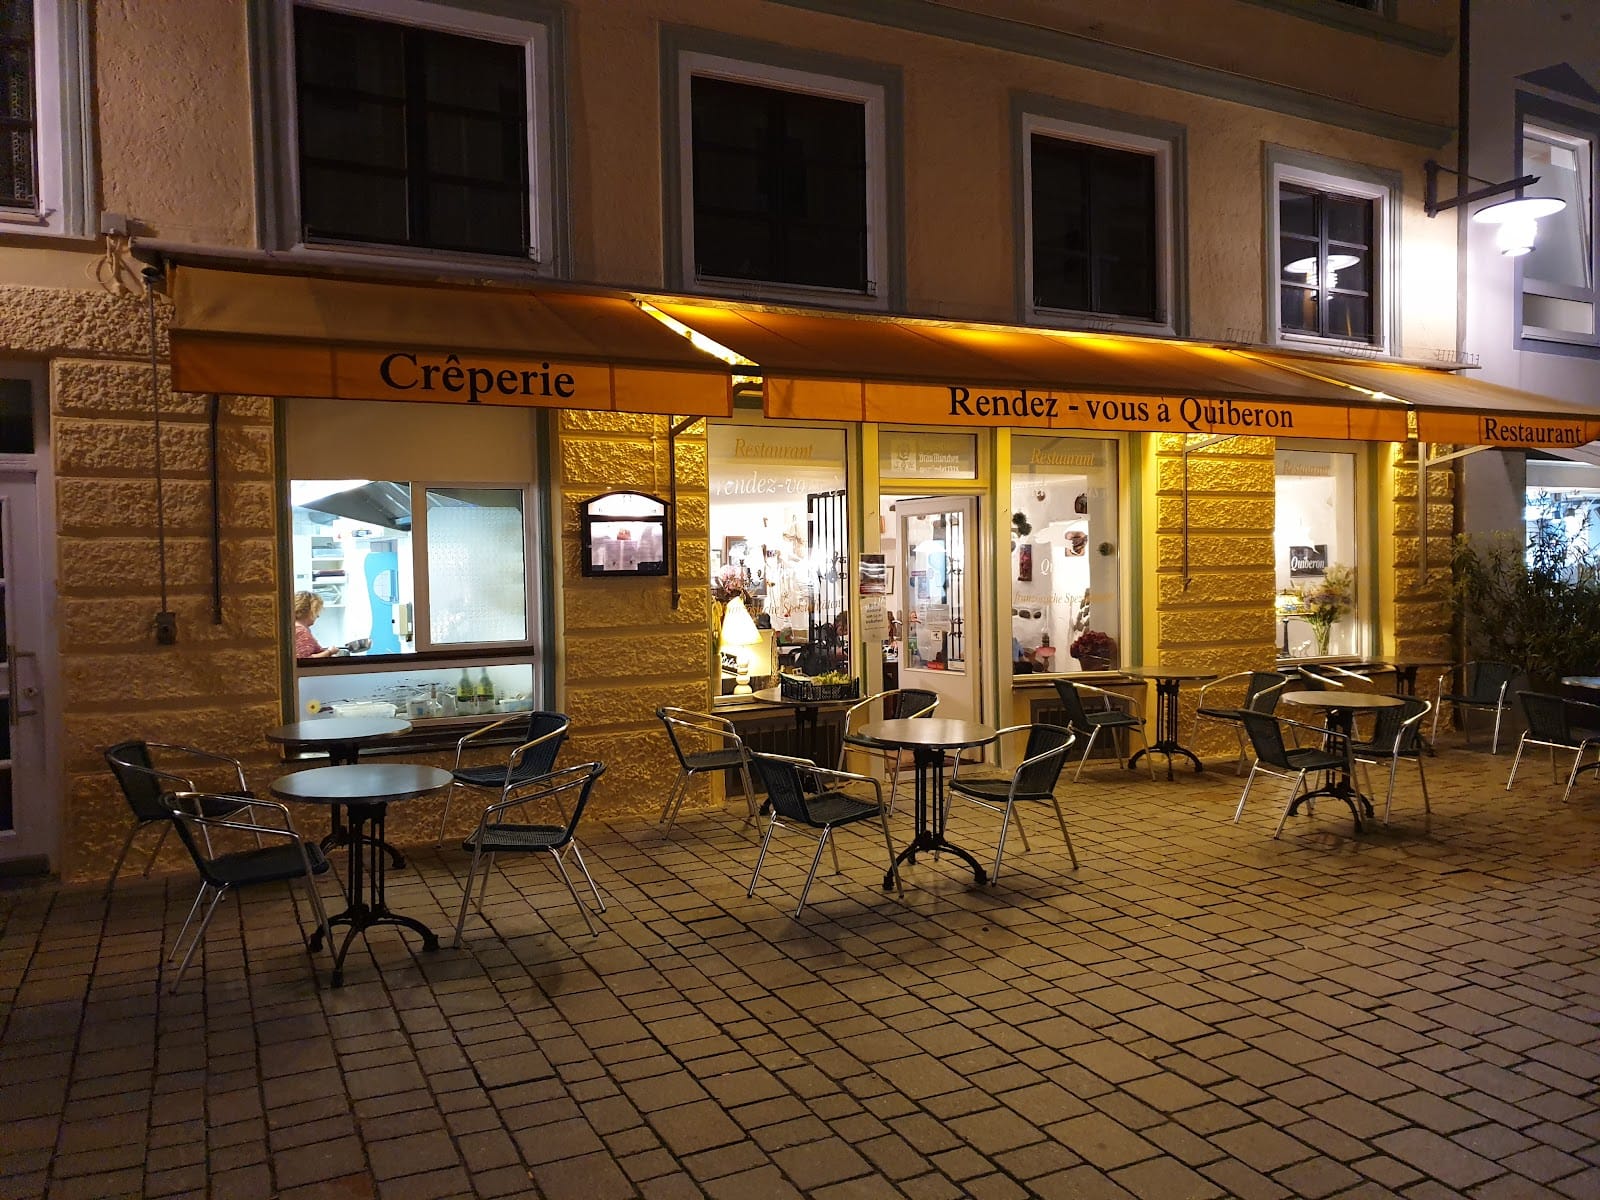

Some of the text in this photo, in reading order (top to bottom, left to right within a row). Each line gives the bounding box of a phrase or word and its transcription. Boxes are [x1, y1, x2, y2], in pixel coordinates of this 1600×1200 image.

[380, 353, 575, 402] Crêperie
[947, 386, 1059, 418] Rendez
[1086, 400, 1149, 422] vous
[1157, 395, 1171, 423] à
[1180, 397, 1294, 431] Quiberon
[1484, 417, 1582, 444] Restaurant
[734, 438, 814, 459] Restaurant
[1030, 447, 1096, 466] Restaurant
[1291, 556, 1325, 571] Quiberon
